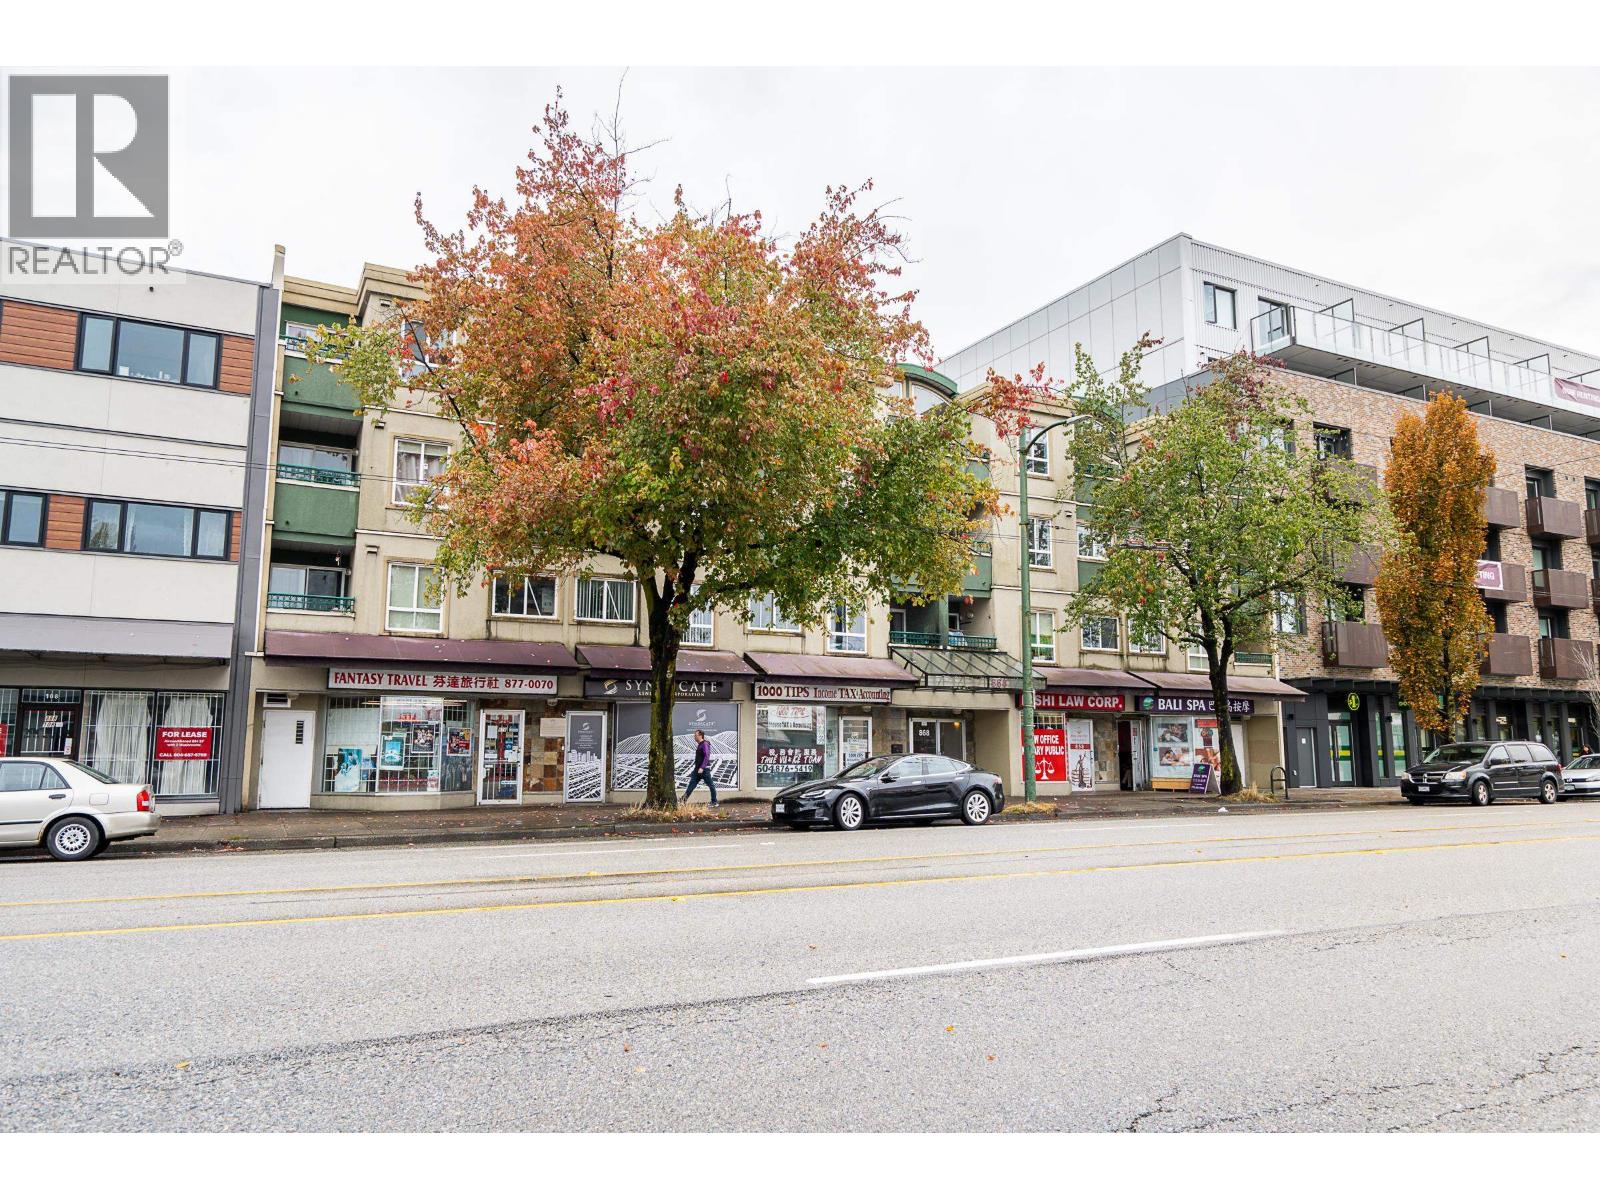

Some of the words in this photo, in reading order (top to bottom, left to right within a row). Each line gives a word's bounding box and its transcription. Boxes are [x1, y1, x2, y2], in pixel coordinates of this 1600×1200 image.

[334, 672, 384, 684] FANTASY
[387, 673, 427, 686] TRAVEL
[504, 679, 554, 689] 877-0070
[625, 680, 717, 692] SYNCATE
[757, 686, 783, 697] 1000
[785, 686, 810, 697] TIPS
[838, 688, 857, 699] TAX
[1058, 695, 1084, 706] LAW
[1087, 696, 1122, 708] CORP.
[1158, 699, 1182, 710] BALI
[1186, 699, 1206, 711] SPA
[1040, 734, 1059, 744] OFFICE
[1044, 746, 1065, 755] PUBLIC
